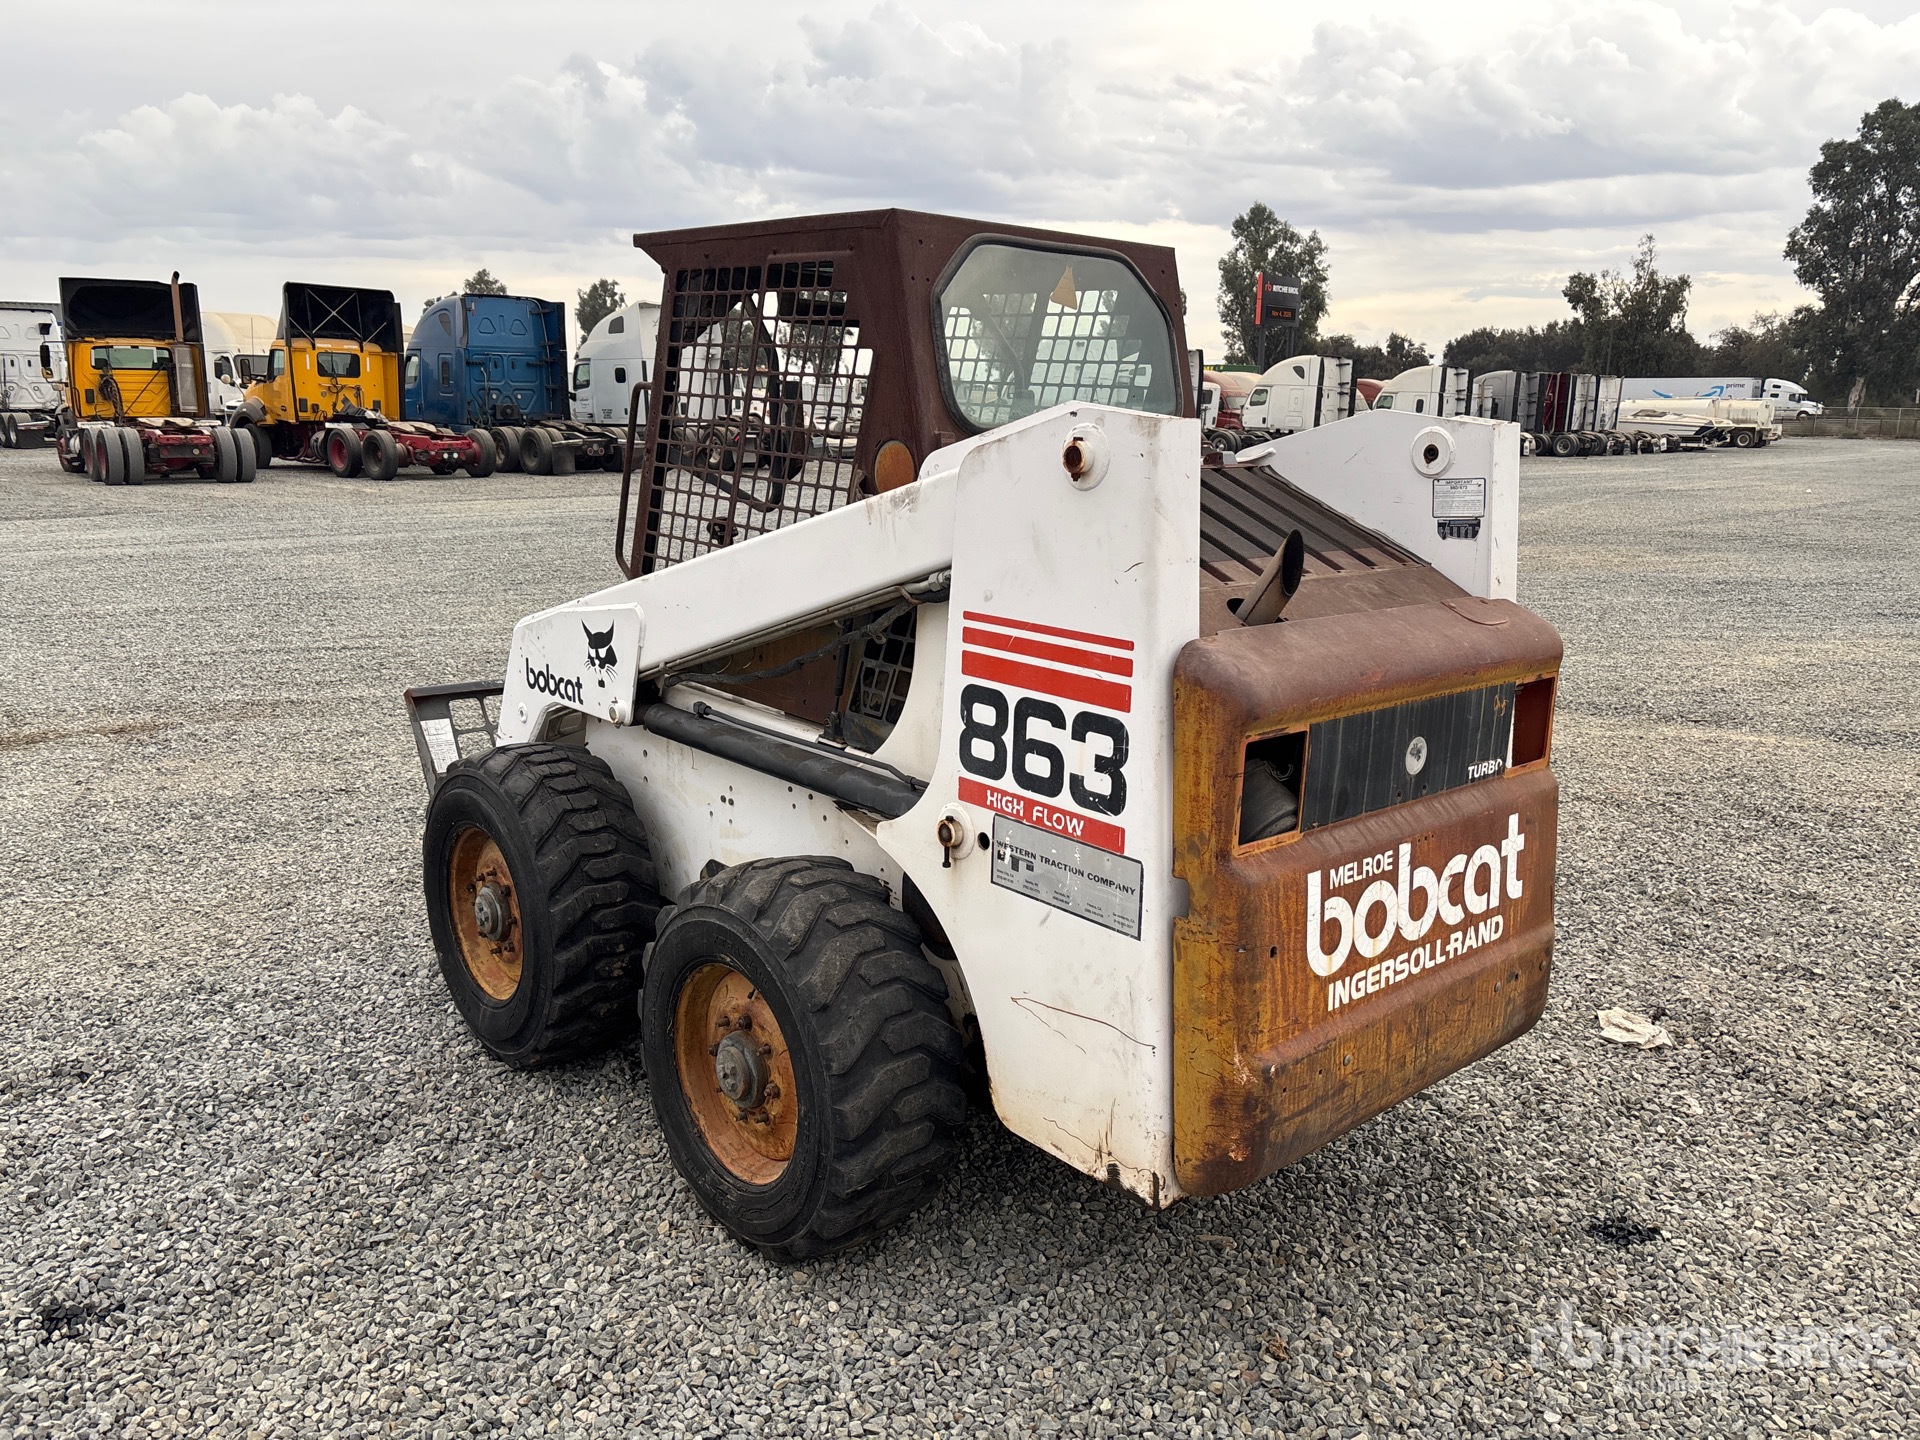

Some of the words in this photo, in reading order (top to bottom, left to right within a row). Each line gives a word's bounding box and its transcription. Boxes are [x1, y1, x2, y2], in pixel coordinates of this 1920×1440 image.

[525, 657, 584, 705] bobcat
[958, 683, 1130, 817] 863
[1468, 758, 1503, 780] TURBO
[986, 789, 1024, 817] HIGH
[1032, 805, 1084, 836] FLOW
[996, 840, 1037, 860] WESTERN
[1039, 854, 1085, 878] TRACTION
[1087, 872, 1136, 896] COMPANY
[1329, 850, 1394, 890] MELROE
[1306, 812, 1525, 977] bobcat
[1327, 914, 1504, 1012] INGERSOLL-RAND
